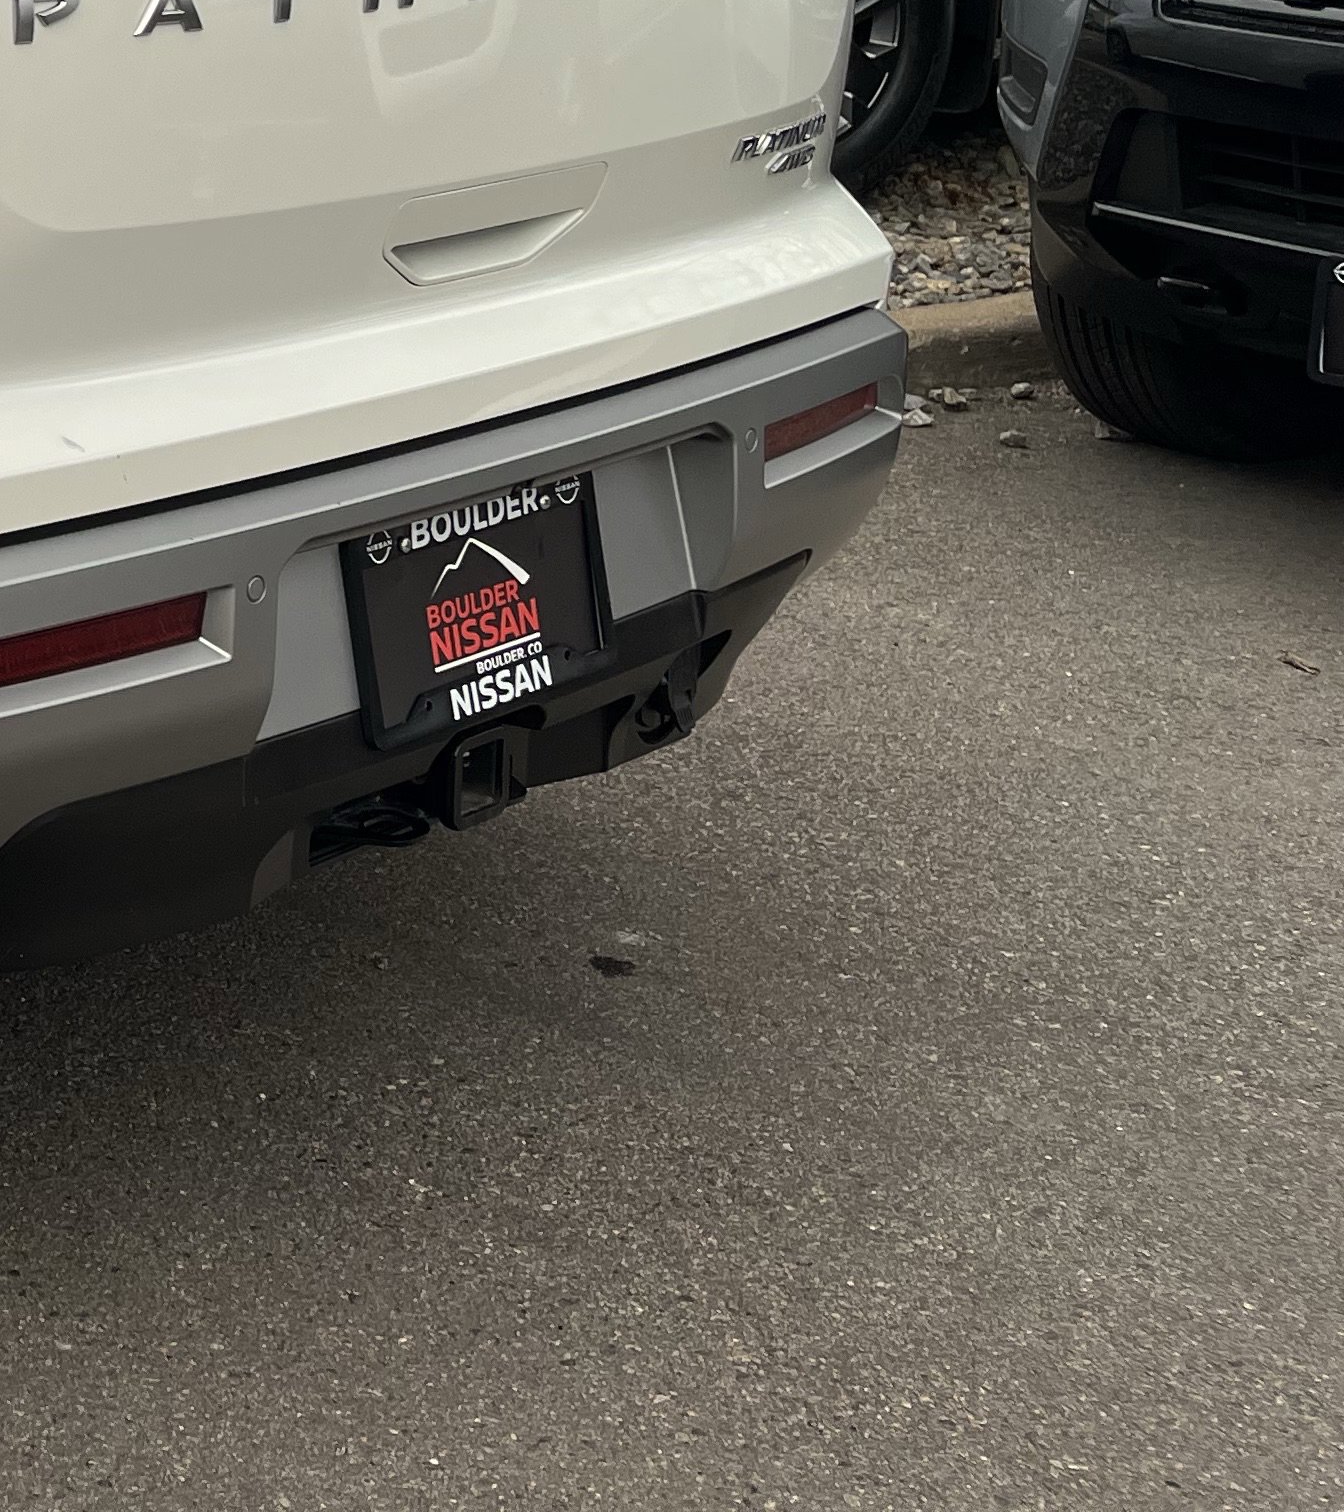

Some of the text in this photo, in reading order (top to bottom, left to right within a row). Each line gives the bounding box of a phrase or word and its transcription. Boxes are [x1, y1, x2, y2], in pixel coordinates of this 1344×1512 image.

[732, 113, 827, 162] PLATINUM
[411, 485, 540, 551] BOULDER
[425, 579, 521, 629] BOULDER
[430, 596, 541, 666] NISSAN
[527, 640, 543, 657] CO
[449, 654, 553, 721] NISSAN
